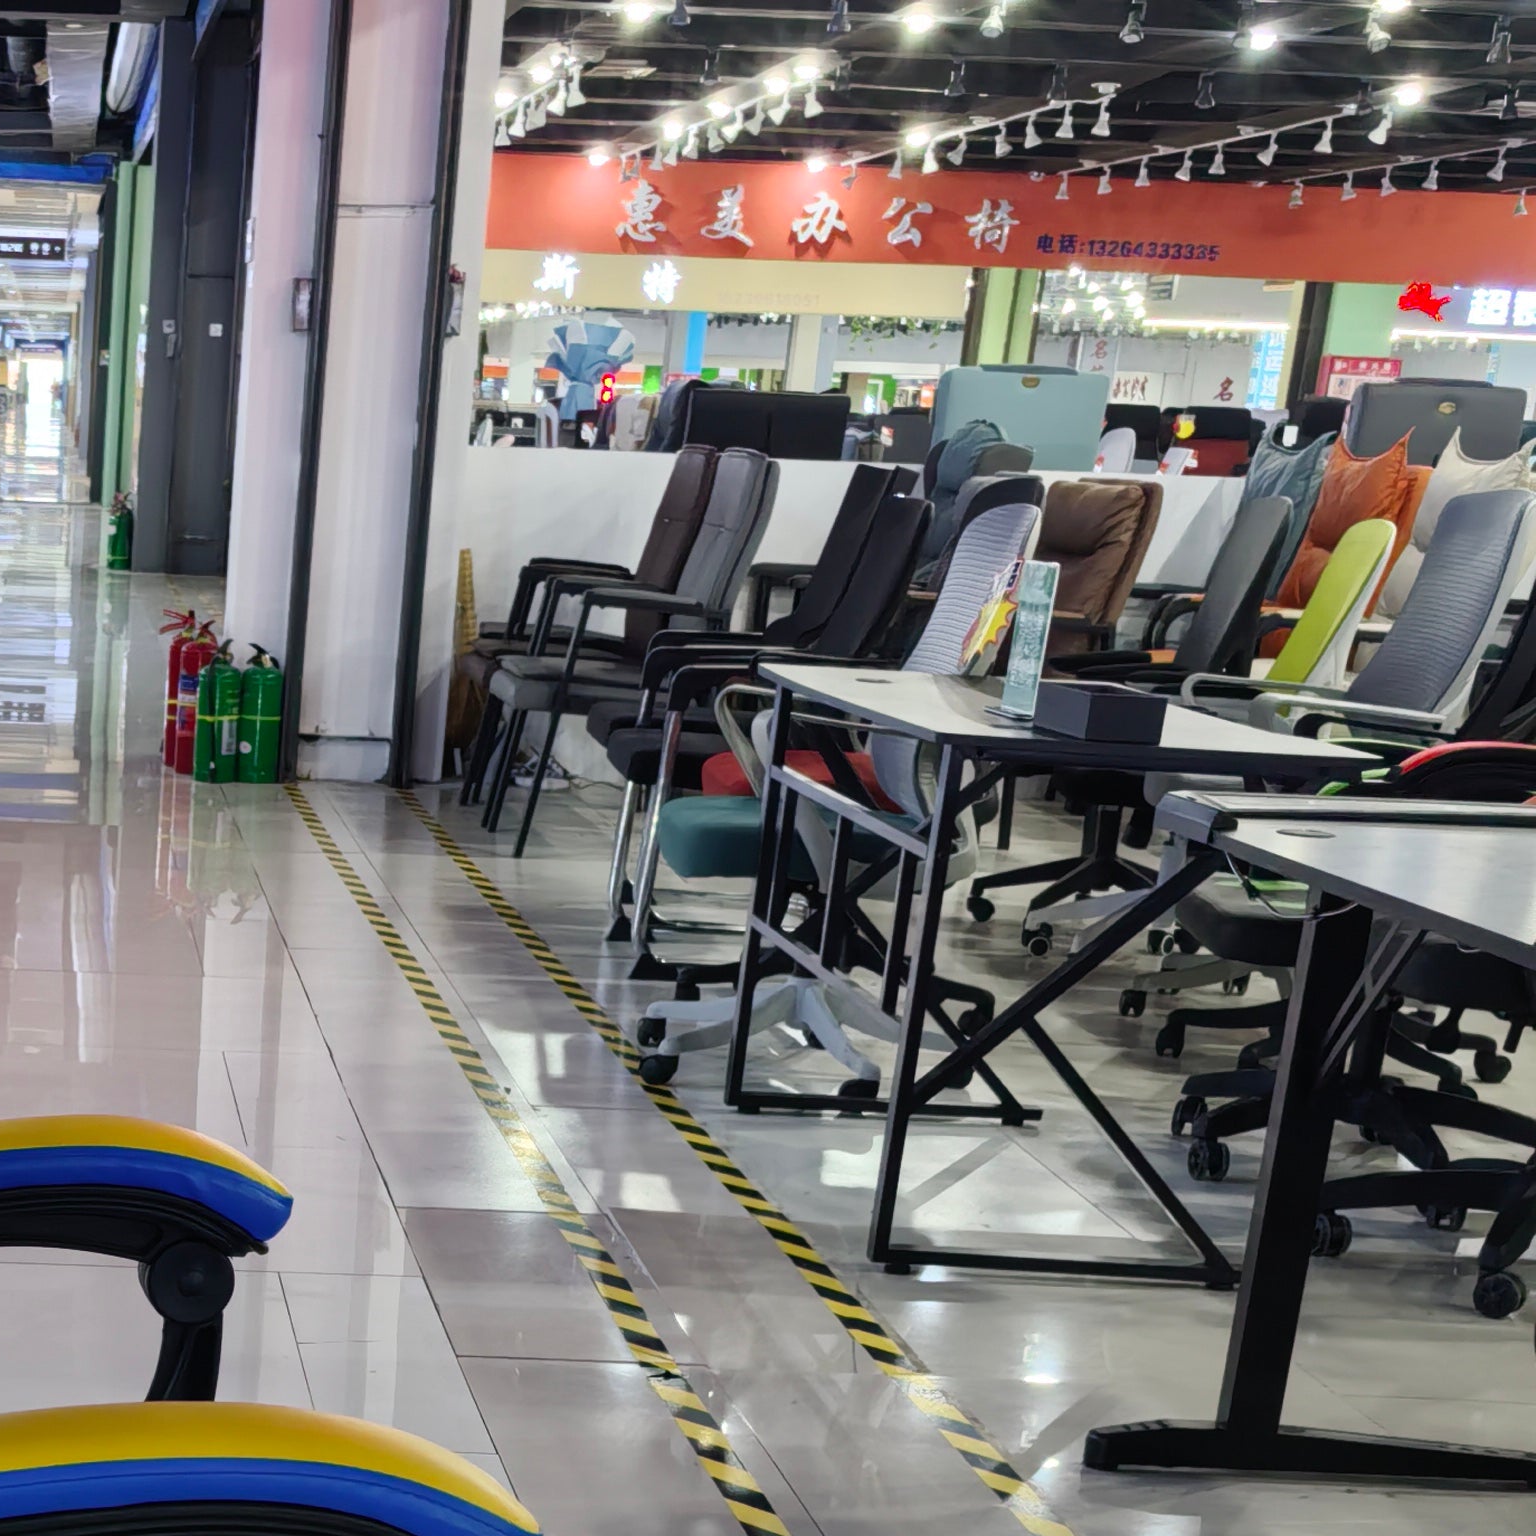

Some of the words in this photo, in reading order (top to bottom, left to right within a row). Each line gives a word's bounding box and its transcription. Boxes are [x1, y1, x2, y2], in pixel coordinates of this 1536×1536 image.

[616, 179, 1021, 254] 惠美办公椅
